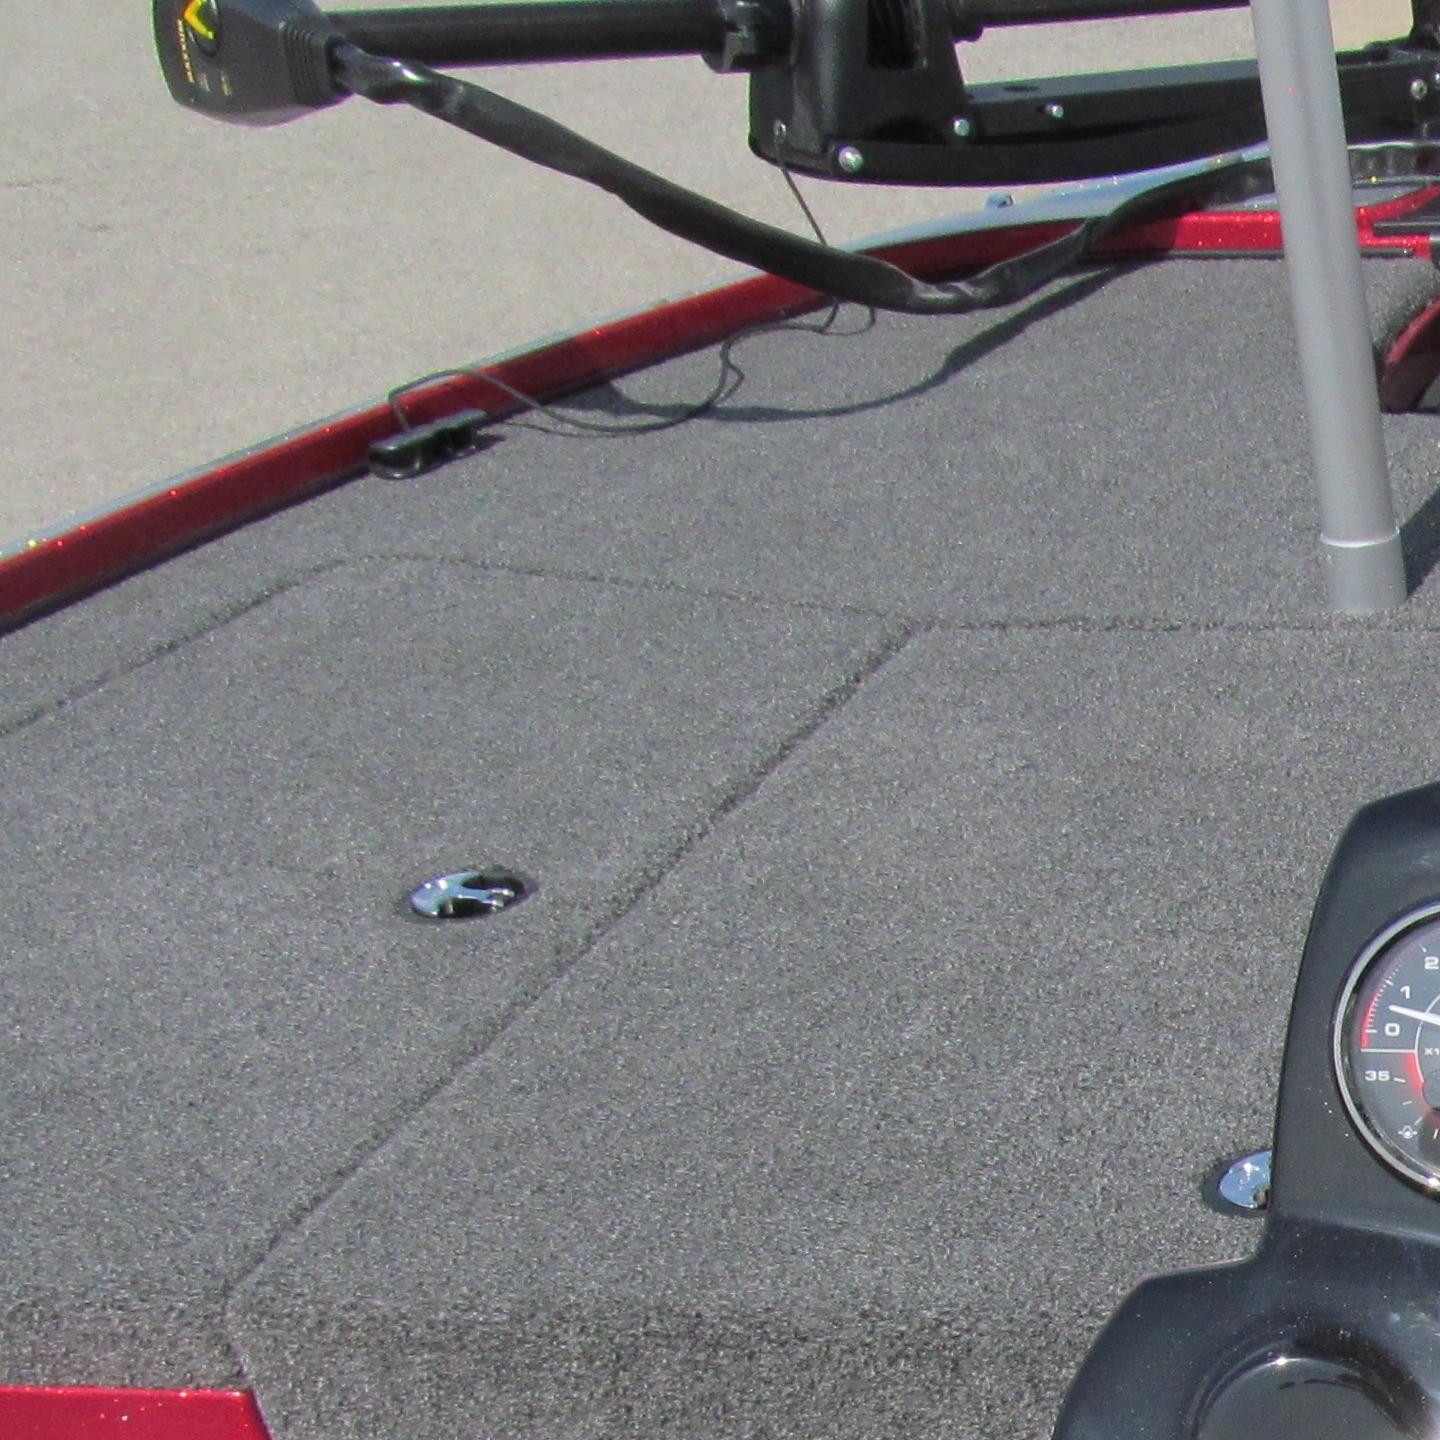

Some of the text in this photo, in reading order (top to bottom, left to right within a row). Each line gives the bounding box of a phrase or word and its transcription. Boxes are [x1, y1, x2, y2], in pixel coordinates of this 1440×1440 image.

[1425, 957, 1440, 971] 2
[1400, 986, 1411, 999] 1
[1385, 1023, 1400, 1037] 0
[1365, 1070, 1391, 1082] 35
